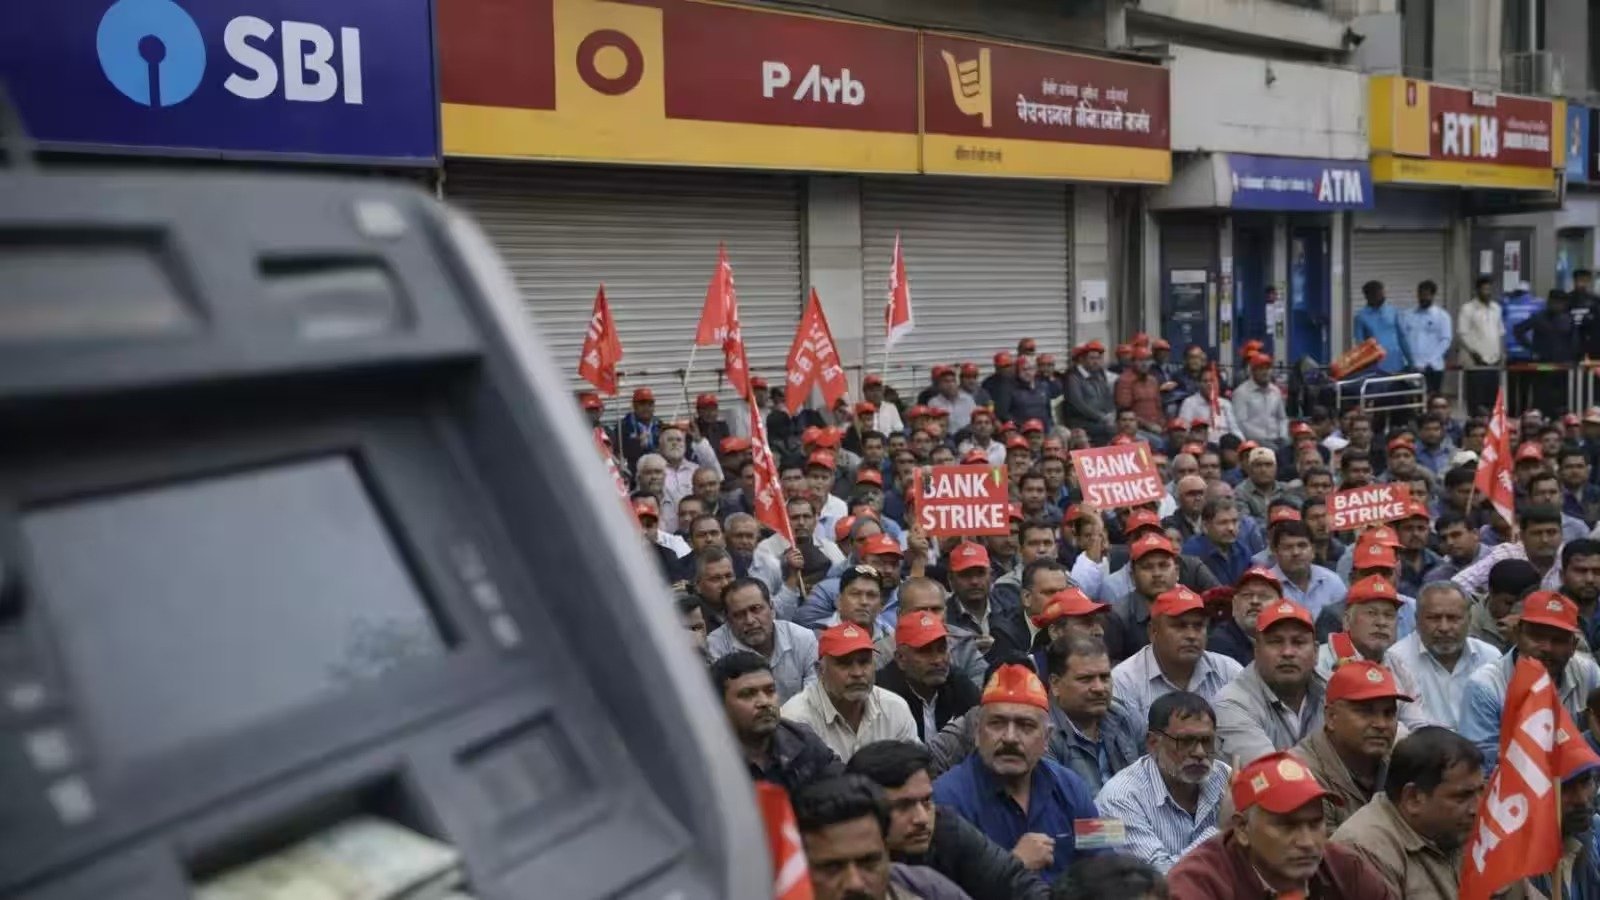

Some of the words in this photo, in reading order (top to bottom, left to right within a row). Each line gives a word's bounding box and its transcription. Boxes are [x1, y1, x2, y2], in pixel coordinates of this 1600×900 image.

[223, 15, 363, 104] SBI
[1318, 168, 1364, 203] ATM
[1087, 476, 1160, 505] STRIKE
[1334, 486, 1393, 510] BANK
[922, 503, 1005, 530] STRIKE
[1334, 502, 1405, 527] STRIKE
